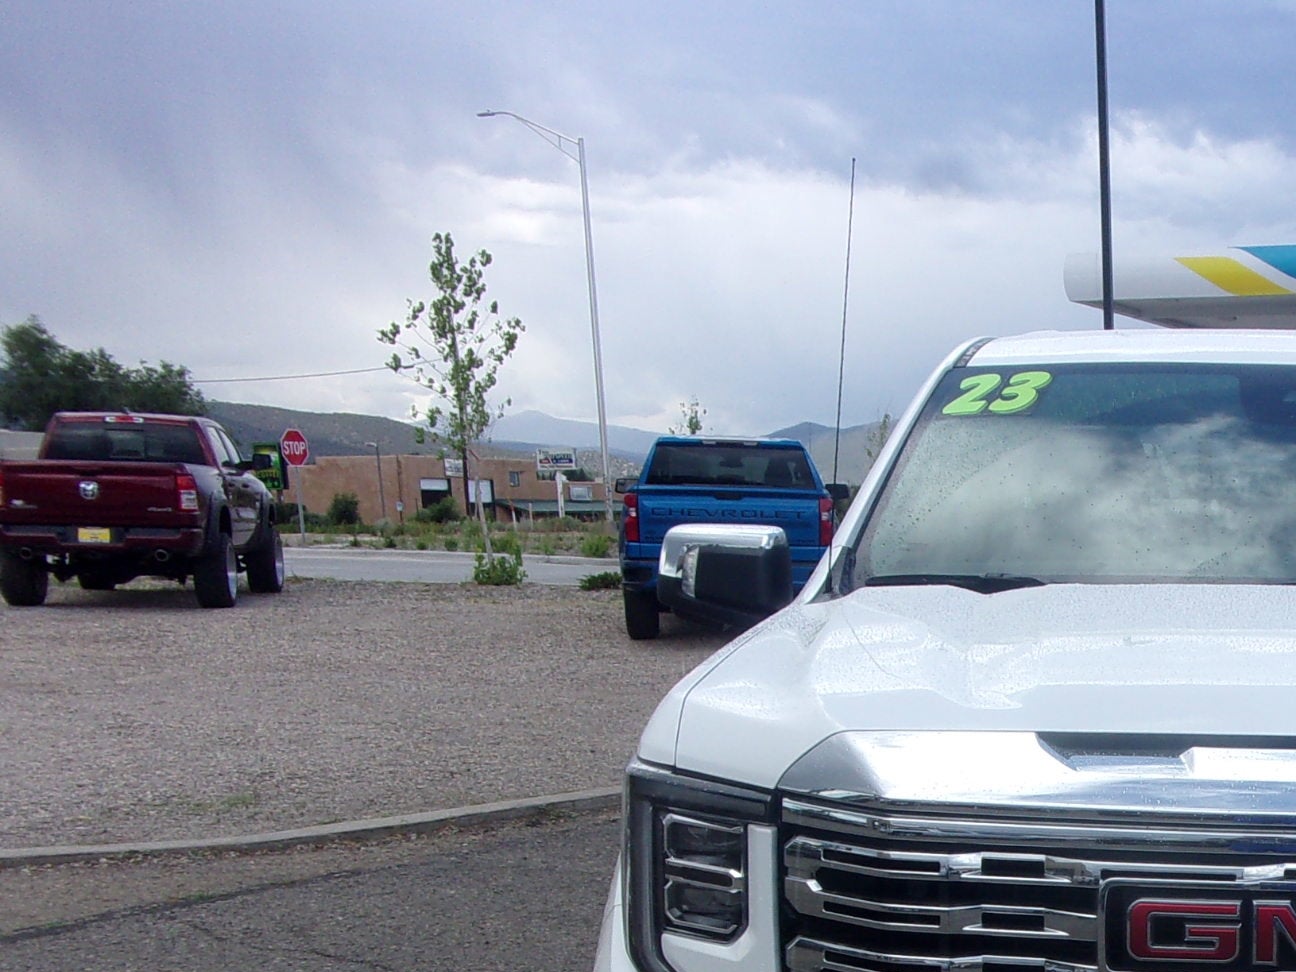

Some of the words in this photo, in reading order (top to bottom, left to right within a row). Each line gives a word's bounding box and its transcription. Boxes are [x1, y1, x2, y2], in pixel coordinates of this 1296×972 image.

[942, 371, 1053, 416] 23
[283, 440, 306, 456] STOP
[650, 507, 807, 521] CHEVROLET
